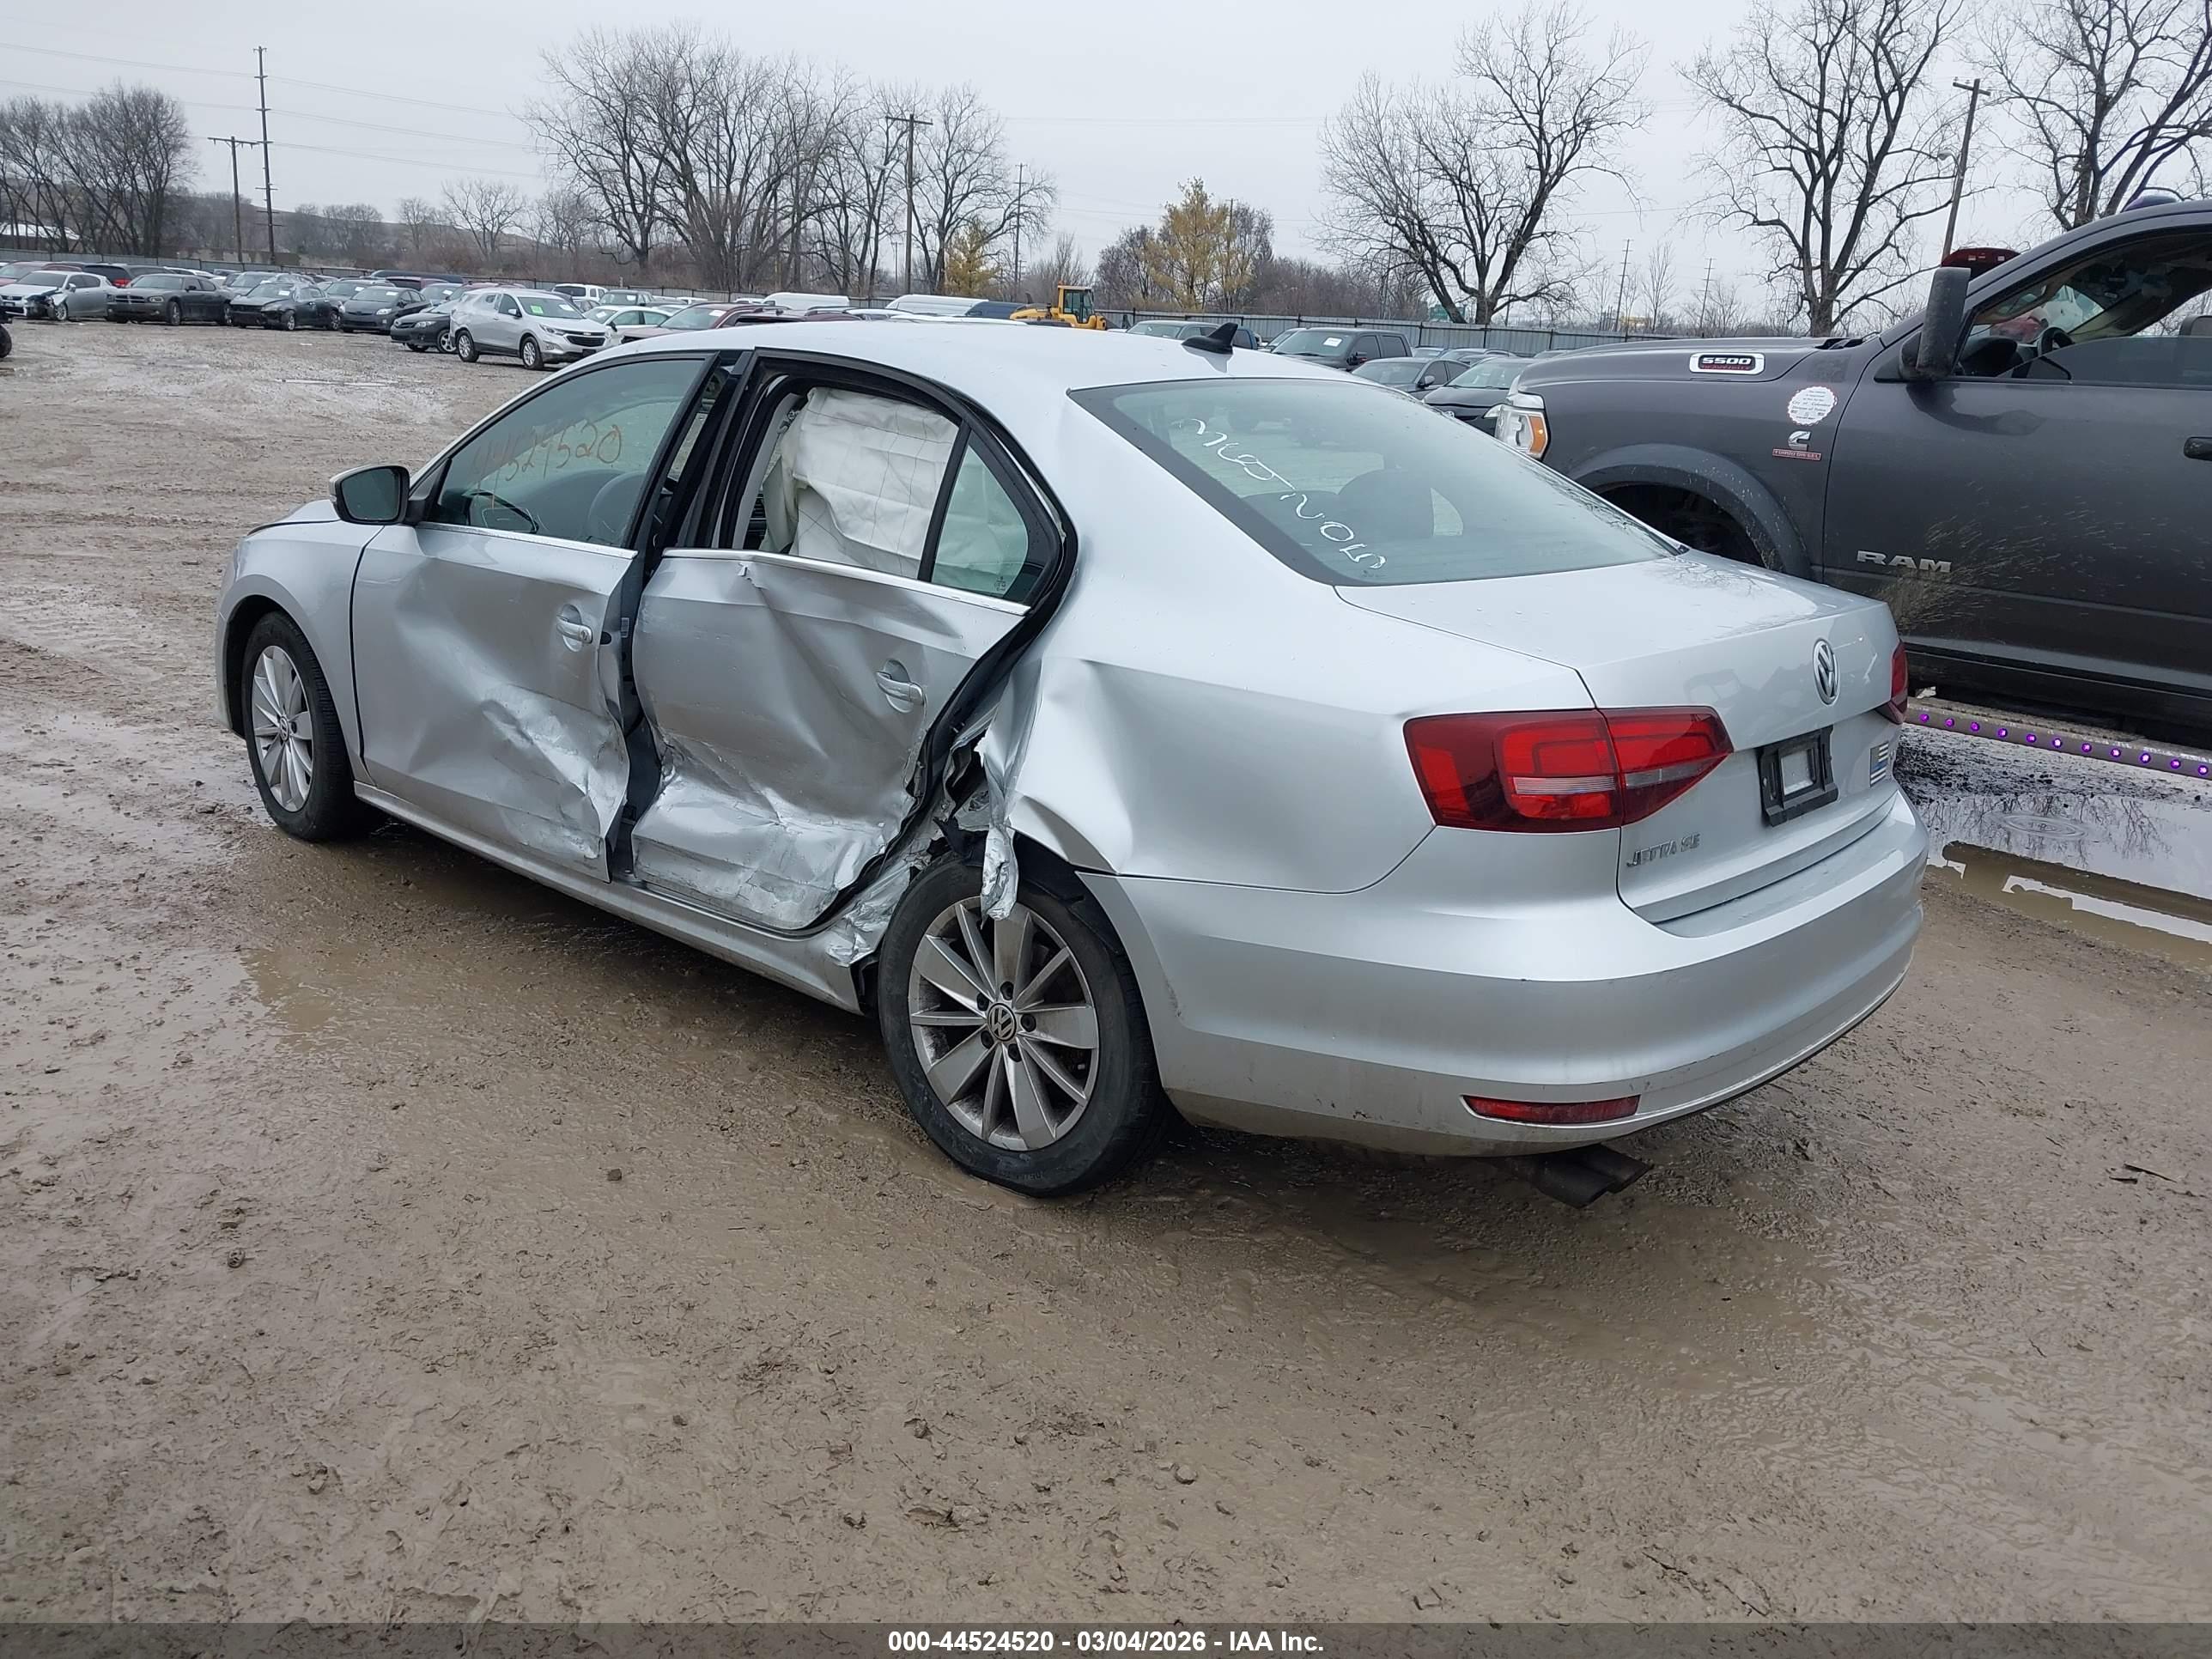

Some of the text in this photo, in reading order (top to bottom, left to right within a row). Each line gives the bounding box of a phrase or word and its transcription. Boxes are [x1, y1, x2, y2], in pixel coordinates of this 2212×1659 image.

[1702, 356, 1752, 365] 5500
[1856, 550, 1952, 573] RAM
[1626, 833, 1701, 867] JETTA SE
